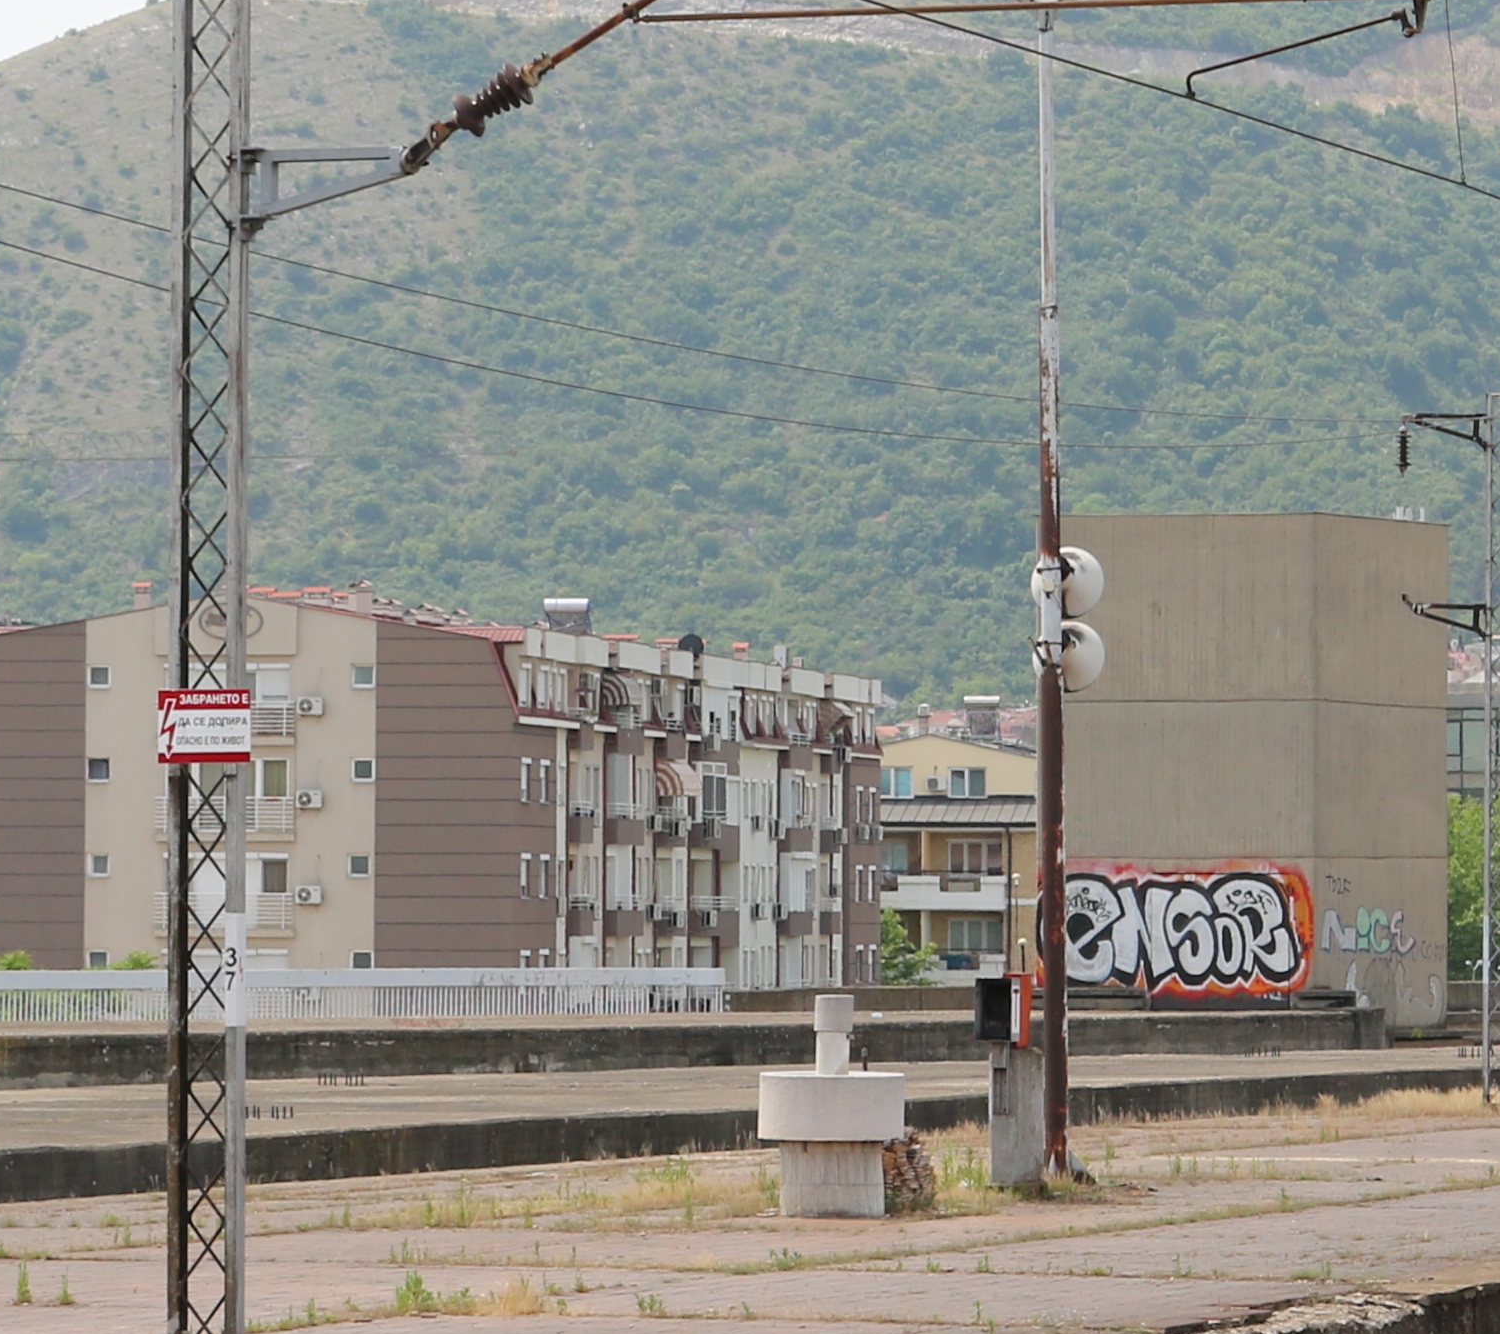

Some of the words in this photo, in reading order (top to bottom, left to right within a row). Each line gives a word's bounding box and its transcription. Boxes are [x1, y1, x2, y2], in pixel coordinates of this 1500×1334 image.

[179, 693, 240, 705] ЗАБРАНЕТО
[241, 693, 249, 704] Е
[177, 717, 191, 727] ДА
[193, 717, 206, 727] СЕ
[208, 717, 248, 727] ДОПИРА
[176, 736, 203, 746] ОПАСНО
[204, 736, 209, 746] Е
[210, 736, 220, 746] ПО
[221, 736, 245, 746] ЖИВОТ
[225, 947, 237, 991] 37
